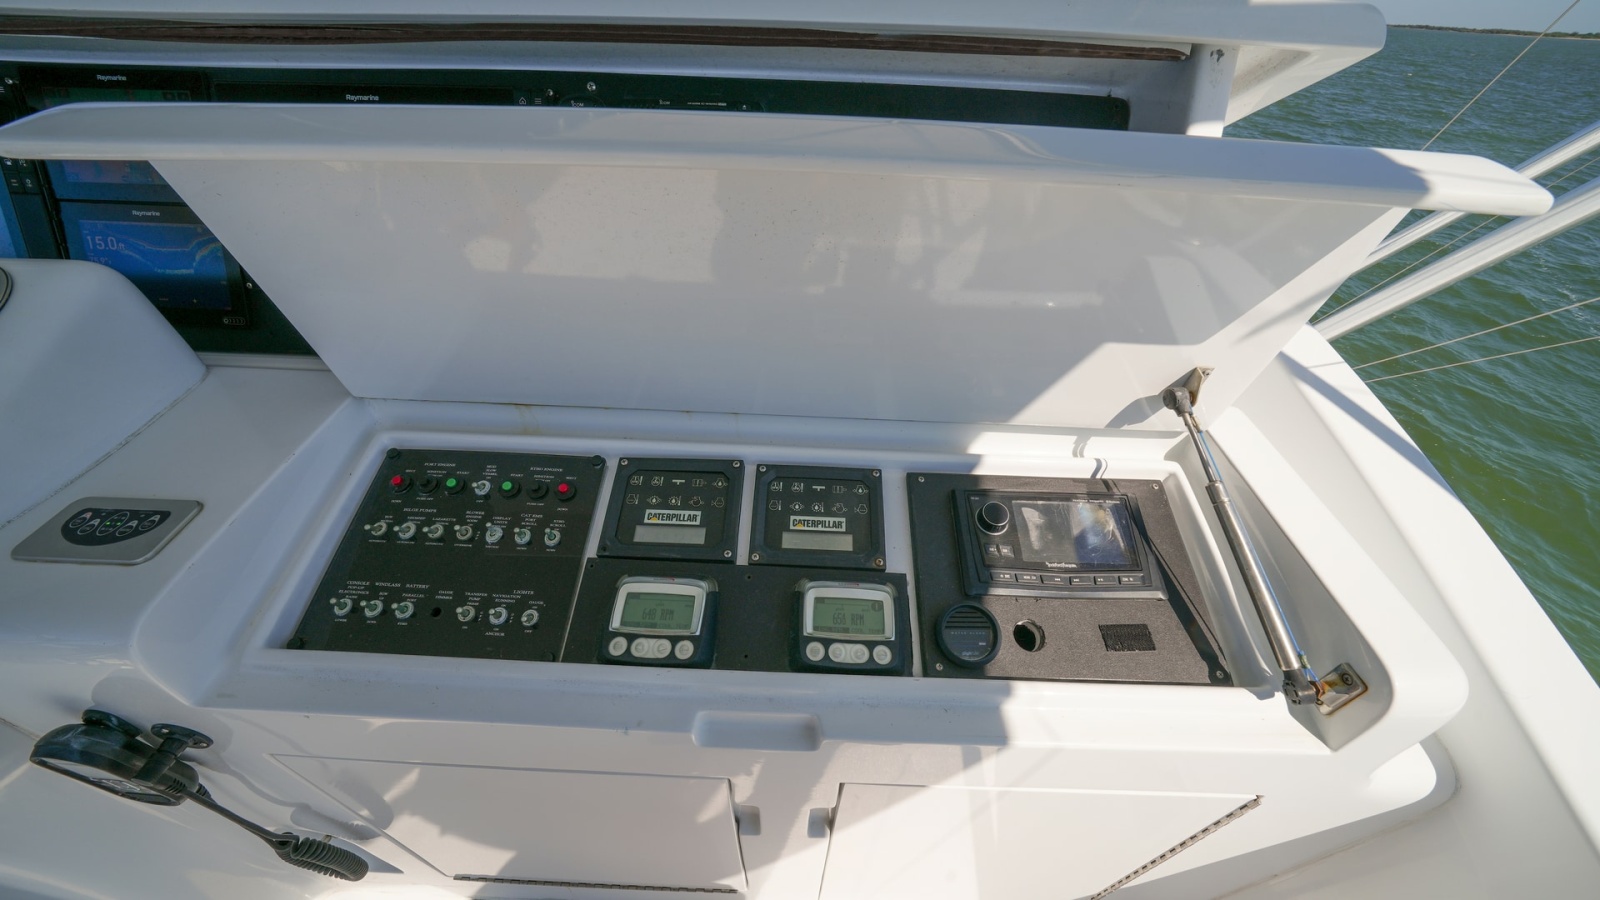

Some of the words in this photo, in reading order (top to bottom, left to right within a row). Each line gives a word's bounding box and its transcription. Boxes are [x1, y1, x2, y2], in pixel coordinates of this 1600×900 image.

[96, 74, 127, 82] Raymarine
[345, 94, 380, 102] Raymarine
[647, 512, 699, 523] CATERPILLAR
[792, 518, 844, 529] CATERPILLAR
[659, 609, 675, 621] RPM
[850, 613, 865, 626] RPM
